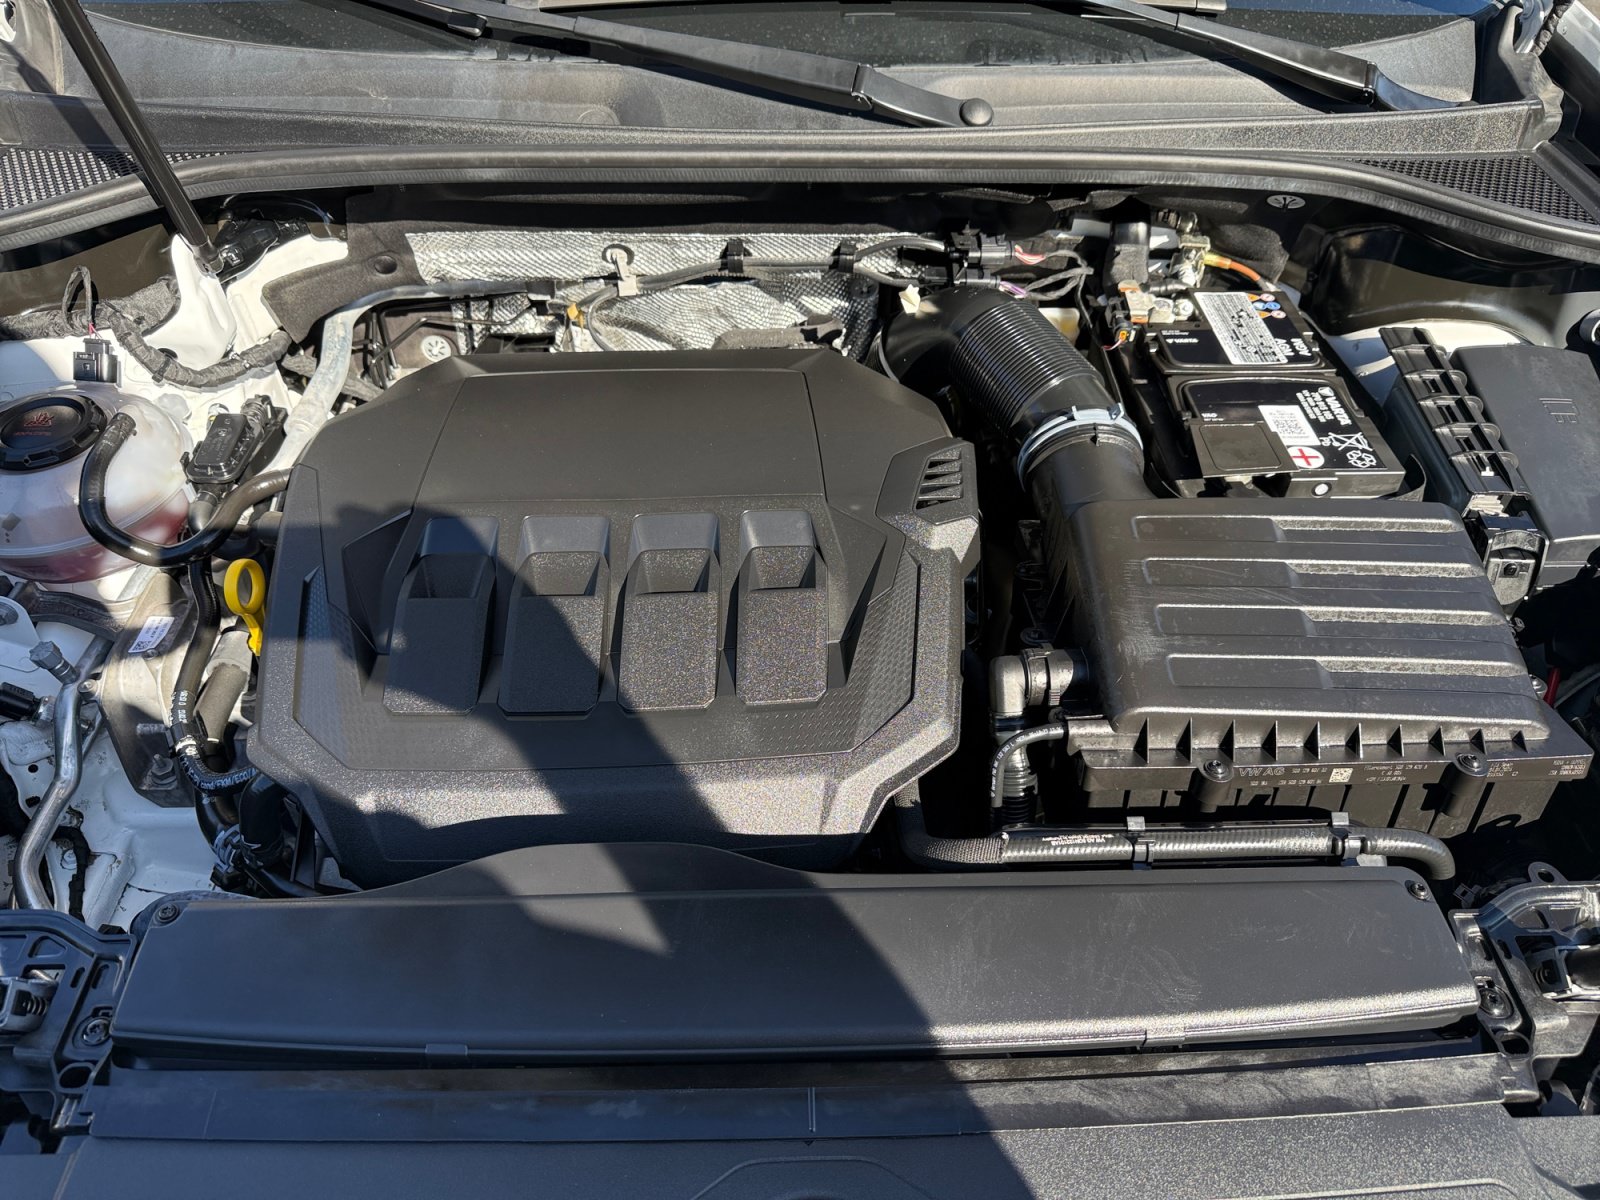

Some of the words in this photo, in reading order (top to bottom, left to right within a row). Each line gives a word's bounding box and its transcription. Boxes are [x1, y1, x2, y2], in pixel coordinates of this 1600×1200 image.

[1275, 338, 1294, 356] AGM
[1325, 396, 1352, 425] VARTA
[1239, 768, 1262, 777] VW
[1263, 767, 1285, 776] AG
